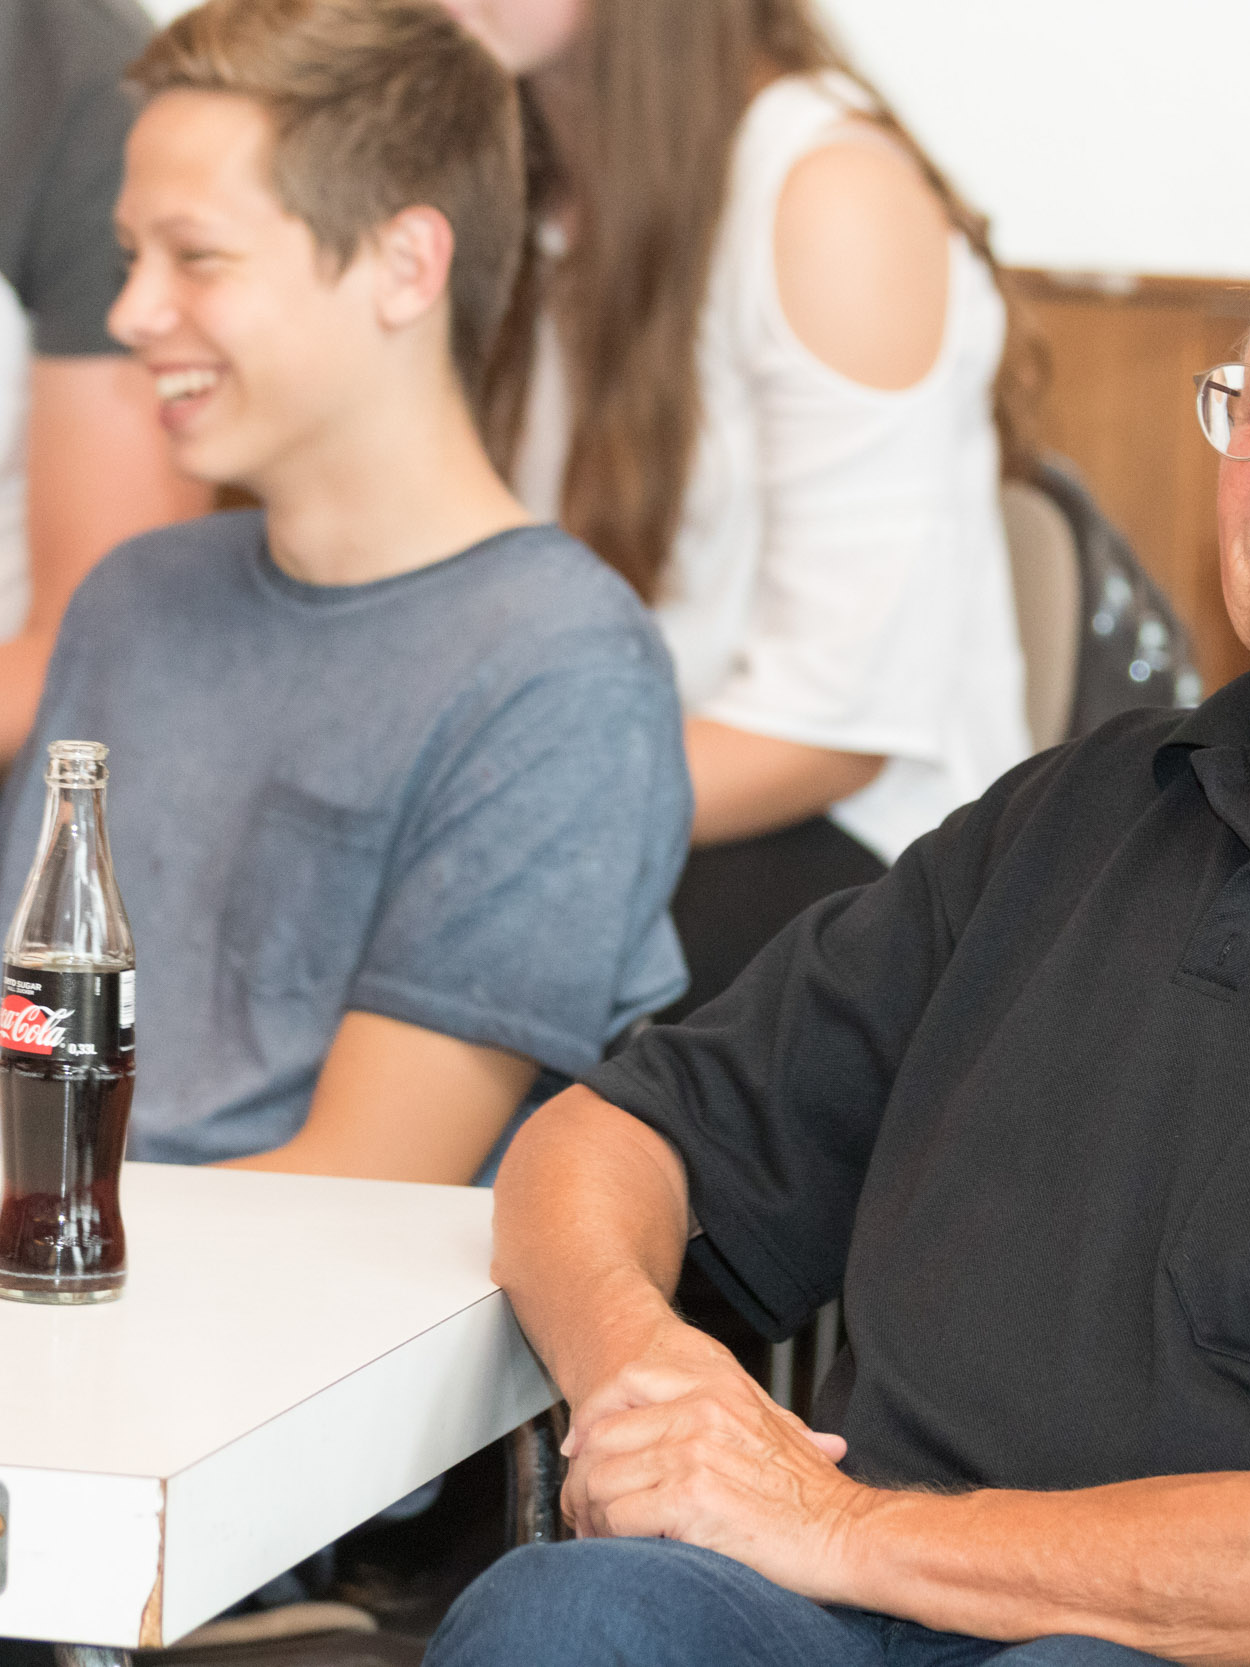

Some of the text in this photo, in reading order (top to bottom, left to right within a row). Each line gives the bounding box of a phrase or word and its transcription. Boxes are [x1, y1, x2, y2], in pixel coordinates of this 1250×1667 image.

[16, 980, 42, 991] SUGAR
[0, 1005, 75, 1047] ca-Cola
[68, 1043, 98, 1057] 0,33L
